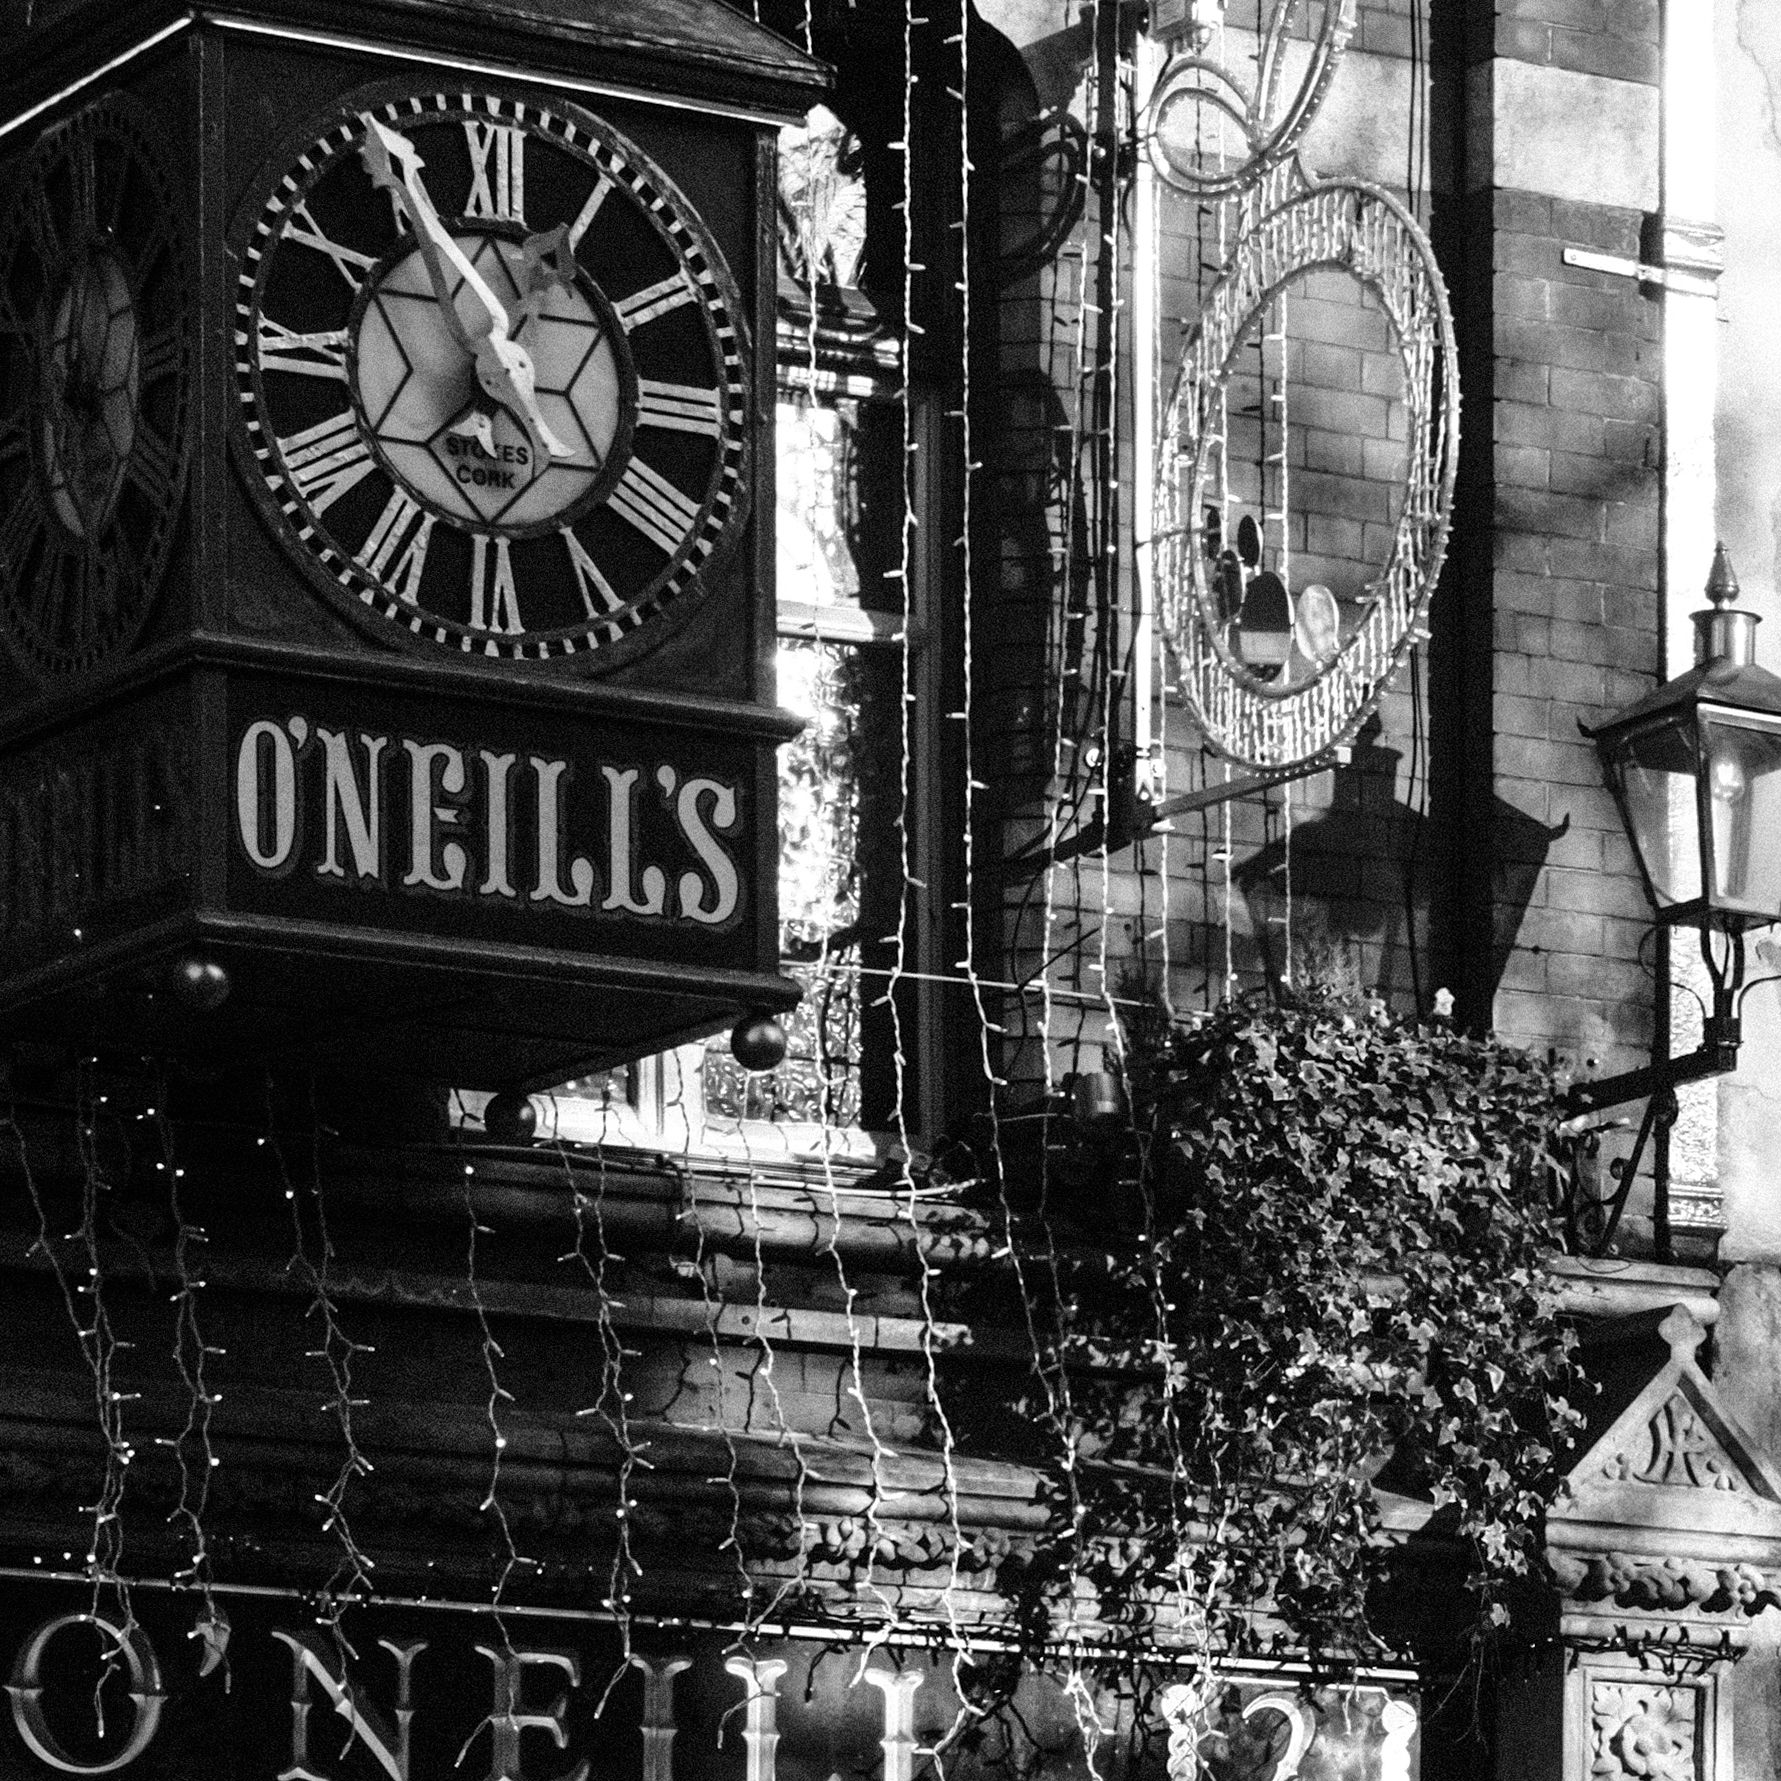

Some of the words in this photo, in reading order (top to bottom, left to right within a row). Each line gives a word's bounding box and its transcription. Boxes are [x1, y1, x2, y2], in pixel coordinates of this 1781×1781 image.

[444, 436, 530, 467] STOES
[455, 464, 516, 490] CORK
[236, 714, 740, 926] O'NEILL'S
